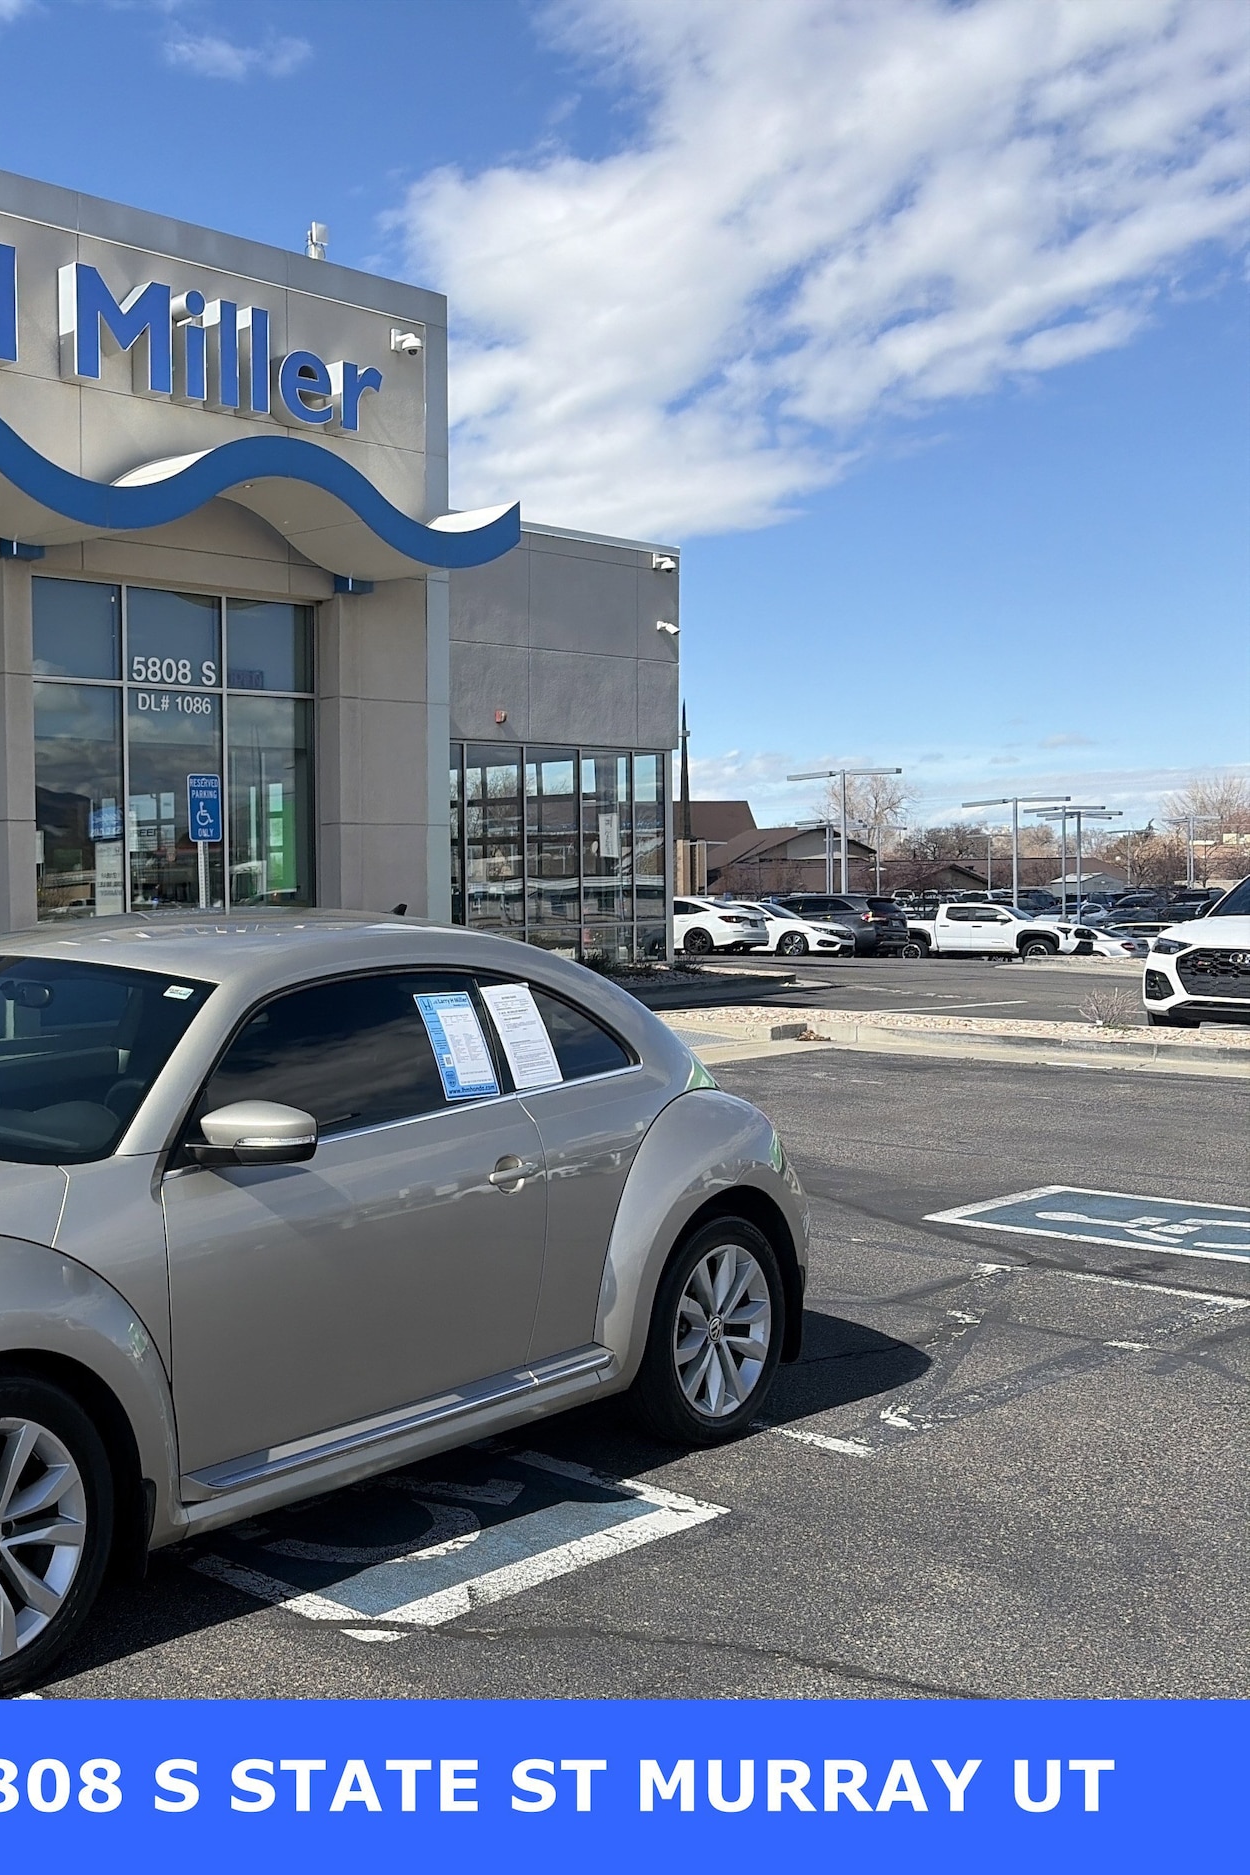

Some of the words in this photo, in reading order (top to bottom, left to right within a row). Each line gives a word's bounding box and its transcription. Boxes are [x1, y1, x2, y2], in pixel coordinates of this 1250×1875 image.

[59, 261, 384, 433] Miller
[132, 656, 192, 684] 5808
[201, 660, 217, 686] S
[137, 692, 170, 712] DL#
[175, 696, 212, 715] 1086
[189, 778, 219, 788] RESERVED
[191, 789, 218, 799] PARKING
[197, 828, 214, 838] ONLY
